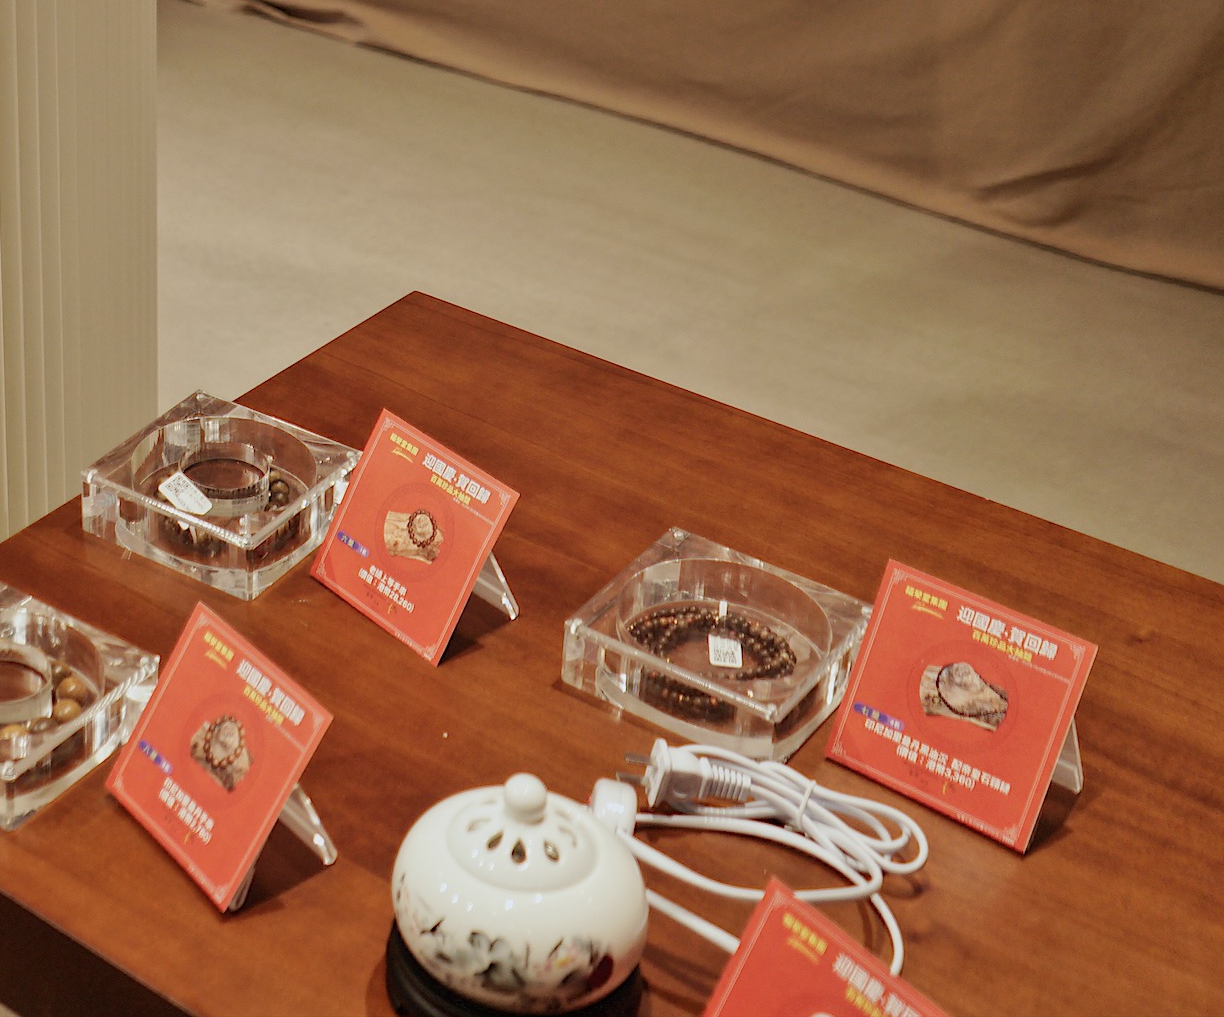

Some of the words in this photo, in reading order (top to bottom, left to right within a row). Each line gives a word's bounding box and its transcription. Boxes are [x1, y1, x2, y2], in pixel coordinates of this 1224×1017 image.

[421, 451, 491, 505] 迎國慶·賀回歸
[956, 604, 1059, 661] 迎國慶·賀回歸
